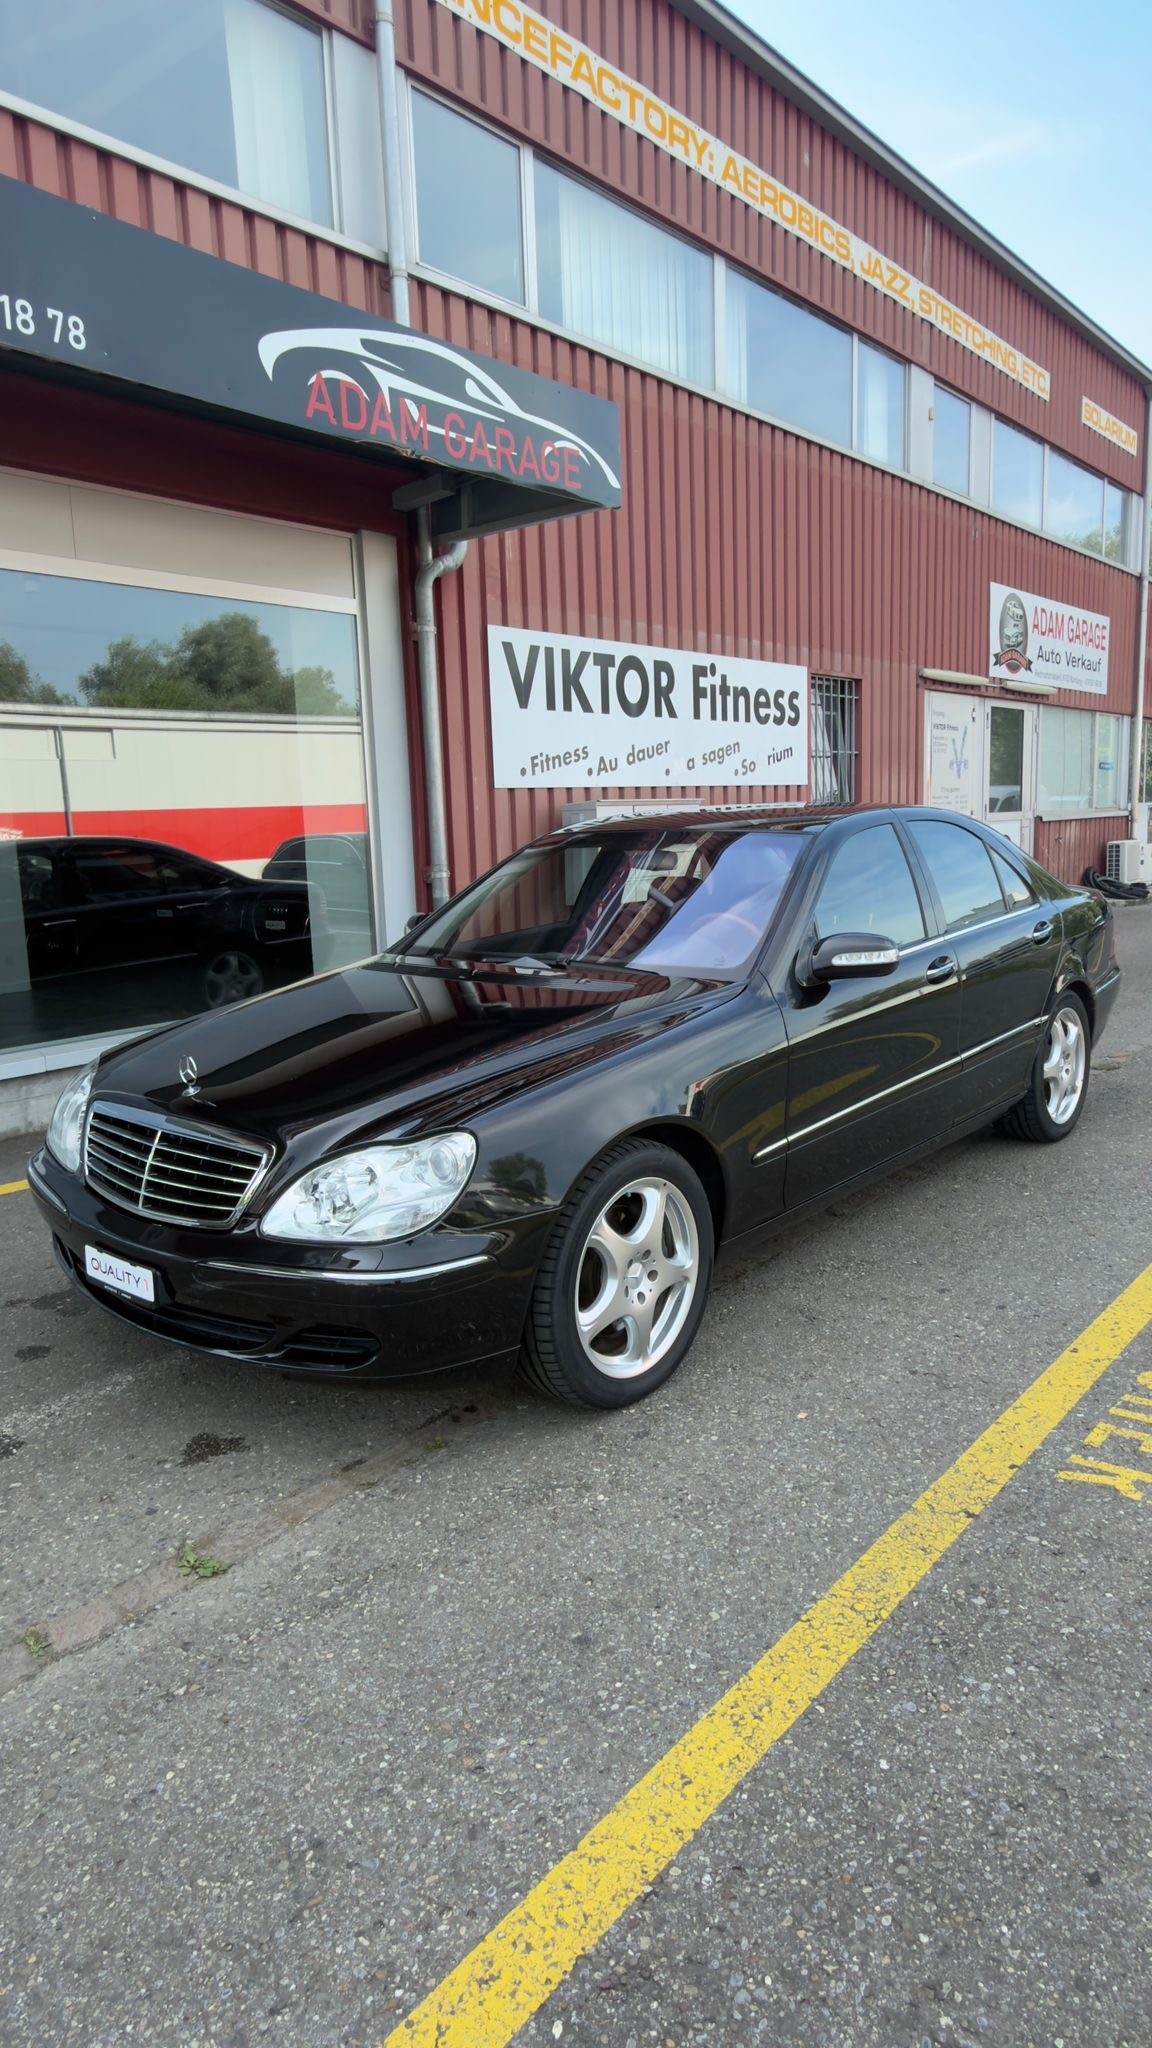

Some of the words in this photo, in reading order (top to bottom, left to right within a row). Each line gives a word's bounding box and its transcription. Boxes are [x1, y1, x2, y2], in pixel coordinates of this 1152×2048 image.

[721, 156, 855, 272] AEROBICS,
[860, 251, 916, 310] JAZZ,
[919, 288, 1020, 379] STRETCHING,
[0, 294, 36, 335] 18
[46, 307, 87, 351] 78
[306, 371, 430, 452] ADAM
[444, 412, 583, 490] GARAGE
[1084, 402, 1136, 449] SOLARIUM
[1032, 606, 1064, 641] ADAM
[1067, 615, 1107, 650] GARAGE
[1037, 645, 1061, 665] Auto
[1065, 651, 1102, 673] Verkauf
[501, 640, 678, 719] VIKTOR
[692, 662, 800, 727] Fitness
[530, 745, 589, 776] Fitness
[91, 1257, 141, 1288] QUALITY
[144, 1278, 150, 1292] 1
